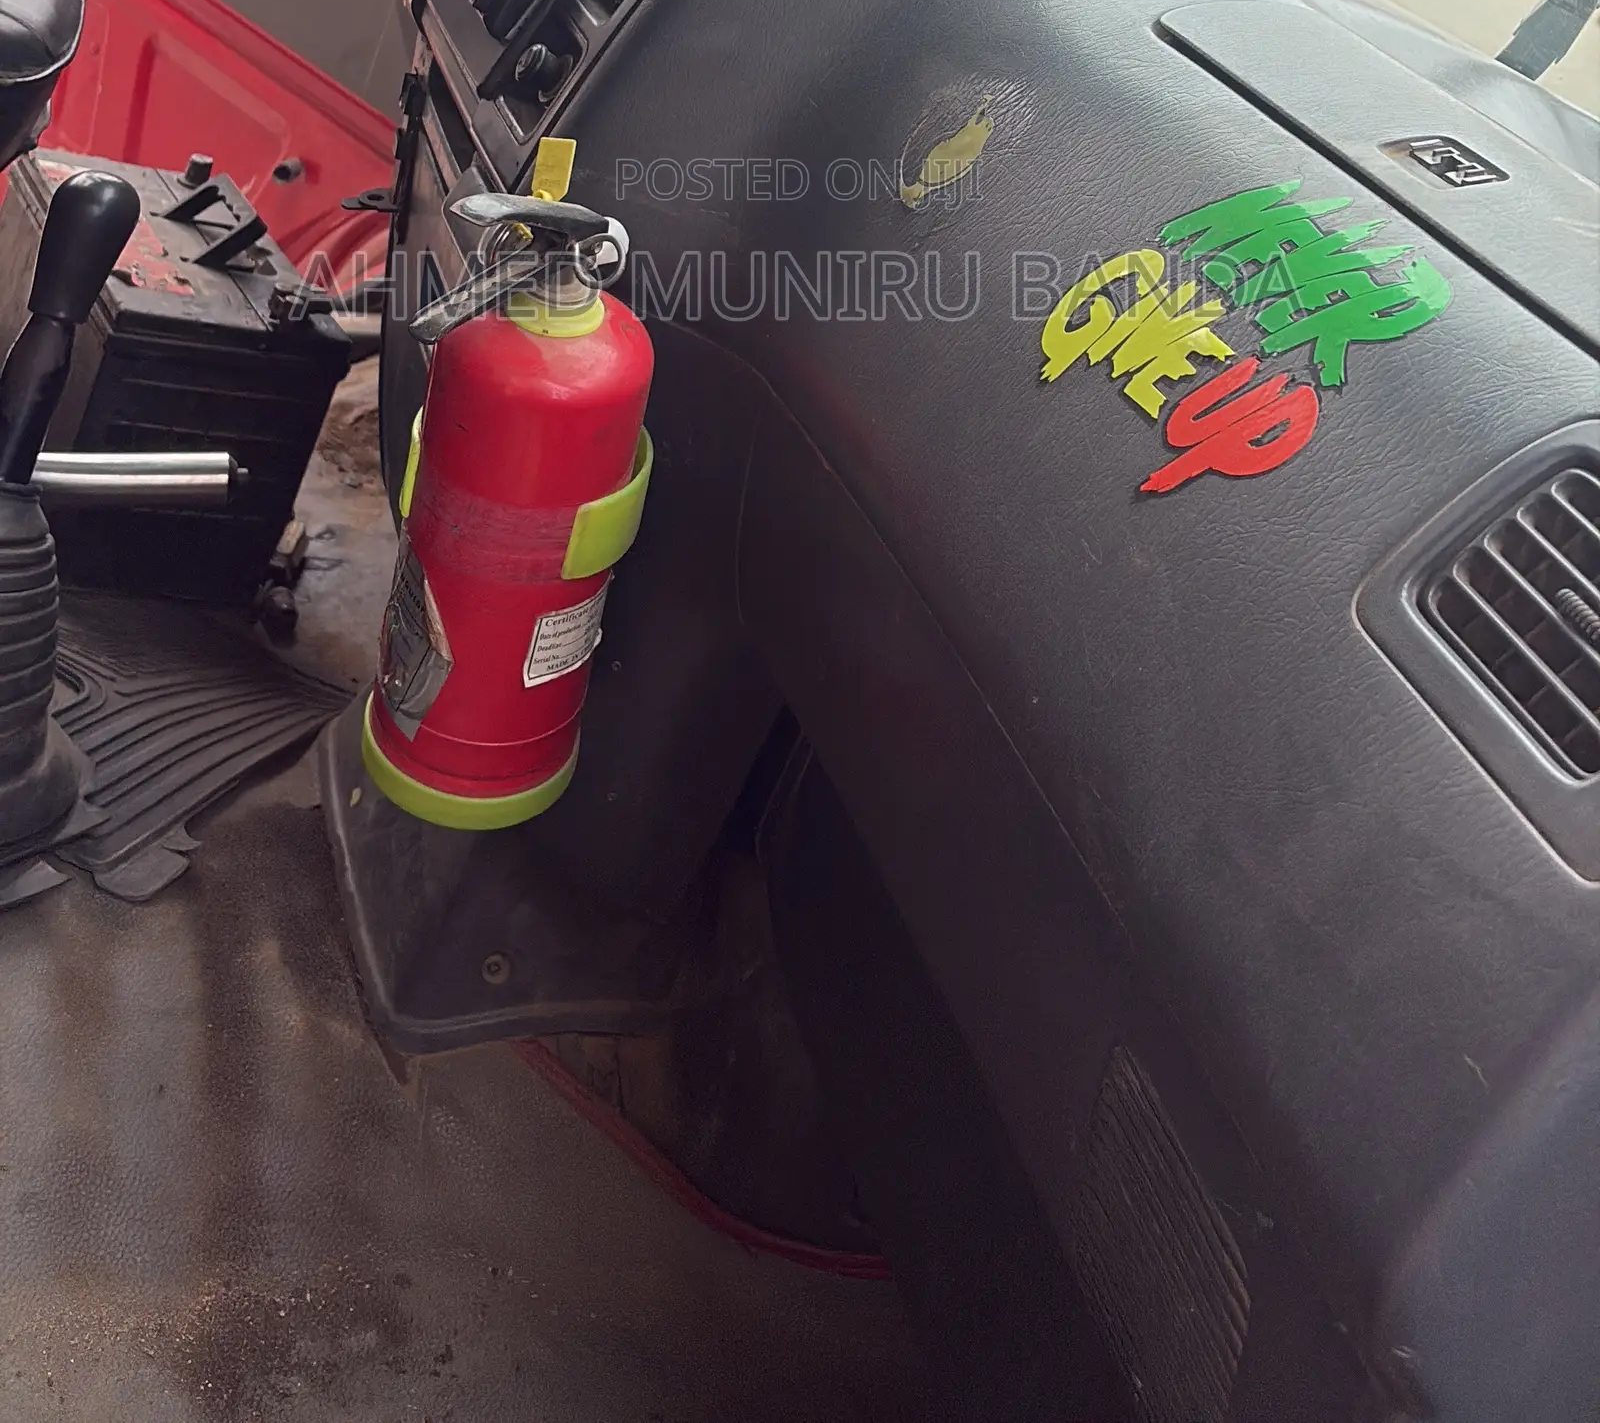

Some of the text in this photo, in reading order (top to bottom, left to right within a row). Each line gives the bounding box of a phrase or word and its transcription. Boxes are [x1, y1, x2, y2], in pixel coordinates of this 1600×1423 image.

[1040, 248, 1235, 420] GIVE
[1157, 178, 1453, 387] NEVER
[545, 608, 588, 627] Certificate
